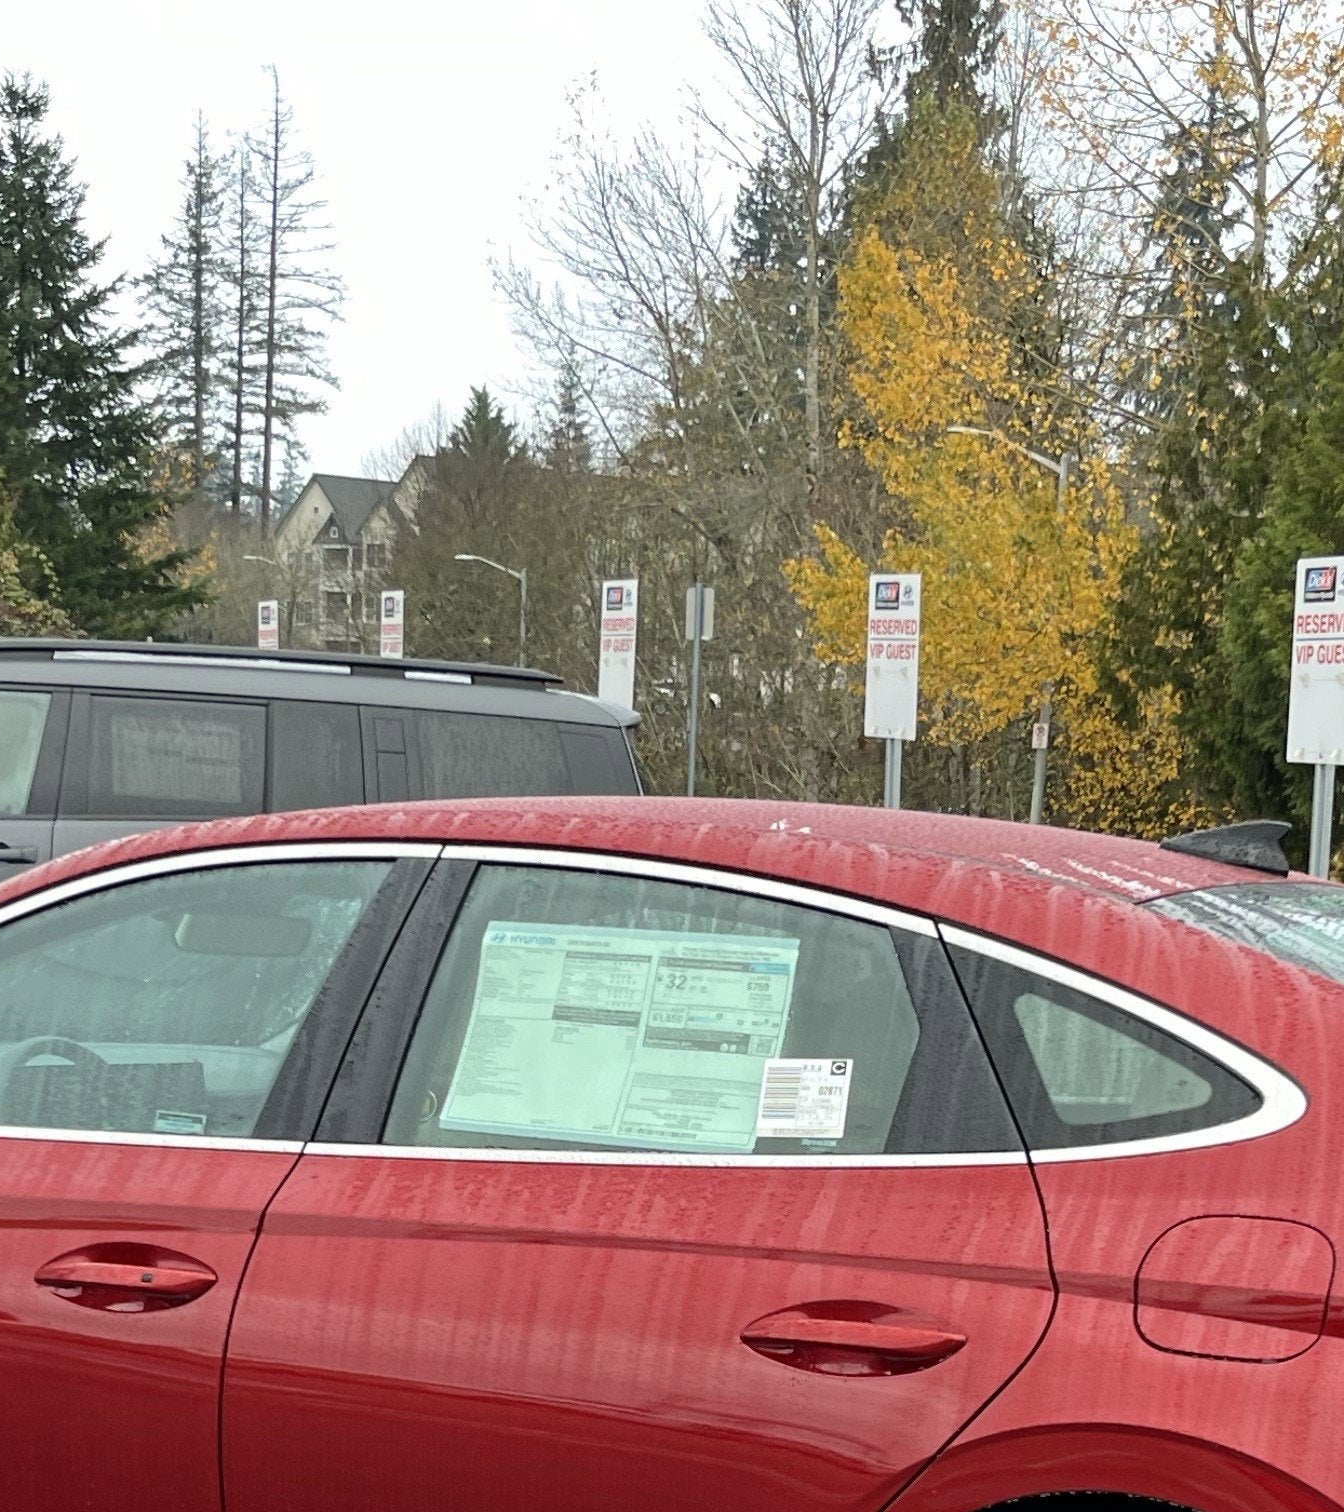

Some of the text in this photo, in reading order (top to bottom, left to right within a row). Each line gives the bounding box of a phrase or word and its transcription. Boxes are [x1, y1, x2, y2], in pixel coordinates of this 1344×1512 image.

[870, 619, 917, 636] RESERVED
[870, 643, 916, 660] VIP GUEST
[1296, 645, 1314, 664] VIP
[666, 974, 687, 990] 32
